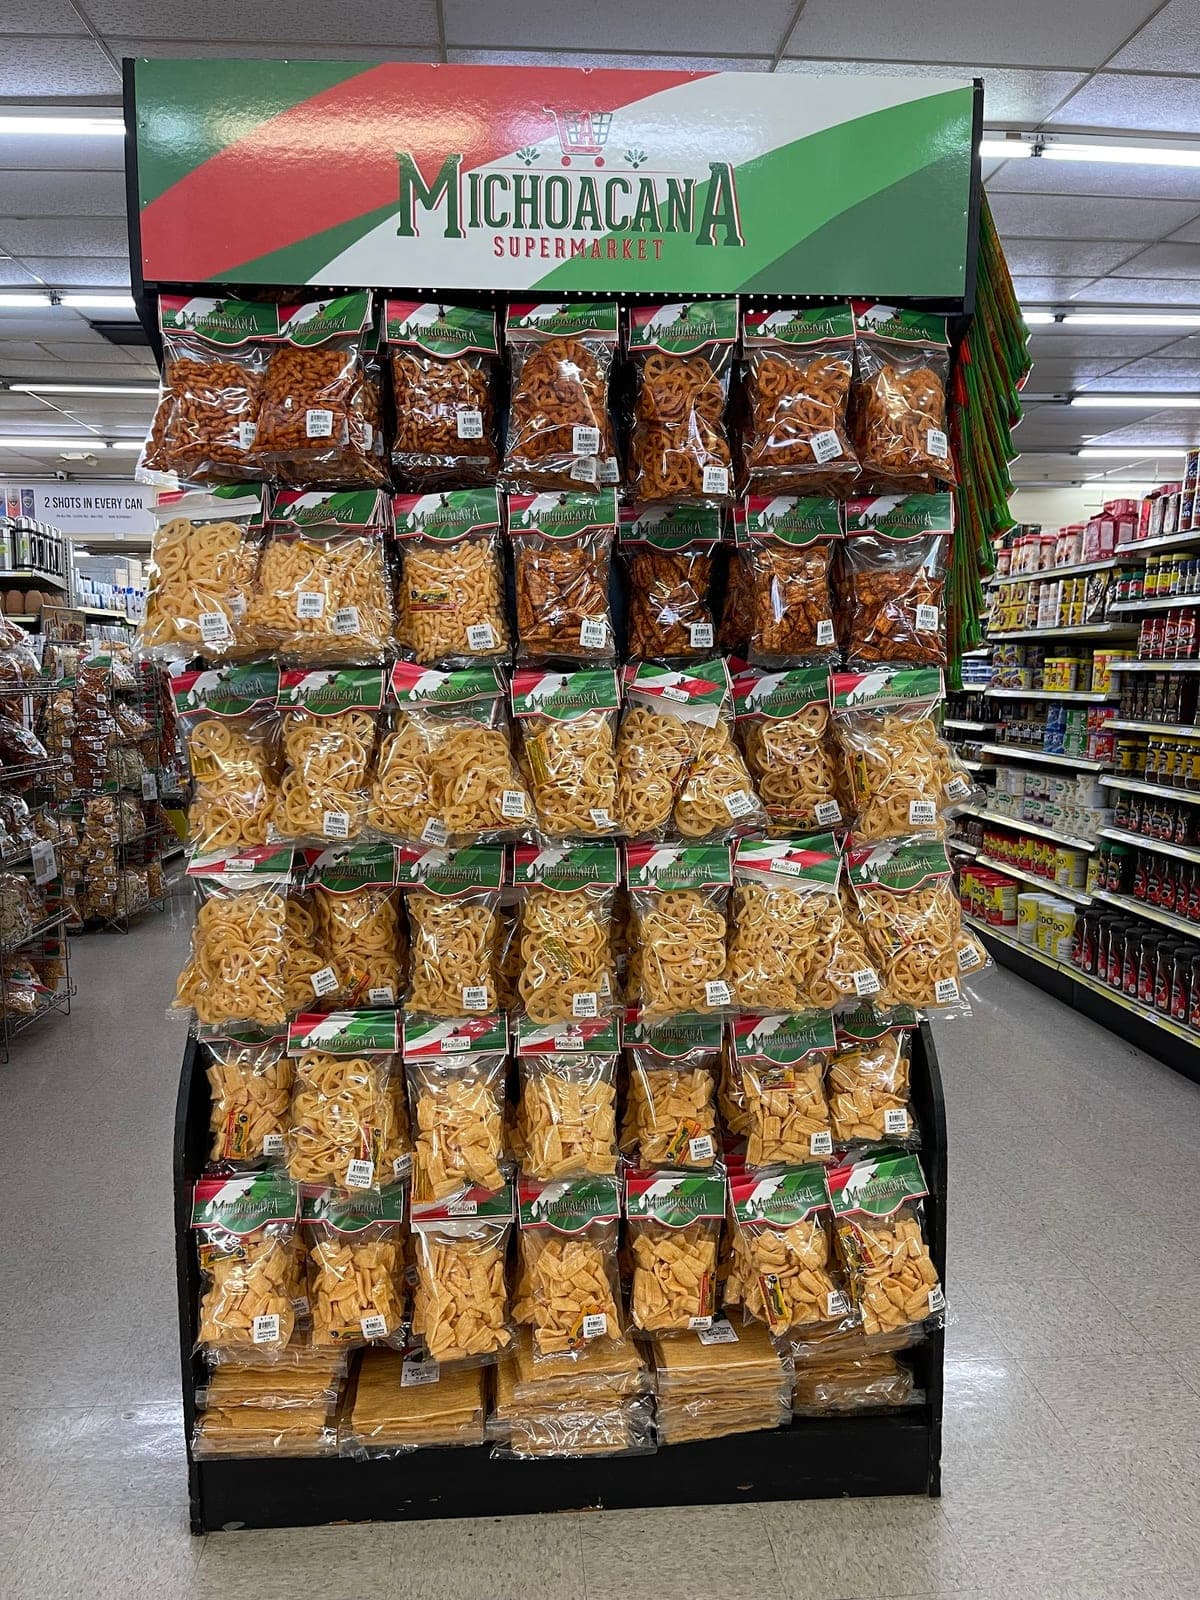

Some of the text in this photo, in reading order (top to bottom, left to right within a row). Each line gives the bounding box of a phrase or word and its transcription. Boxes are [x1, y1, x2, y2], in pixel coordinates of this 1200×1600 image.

[396, 152, 746, 247] MICHOACANA
[493, 236, 664, 260] SUPERMARKET
[44, 496, 143, 510] 2 SHOTS IN EVERY CAN
